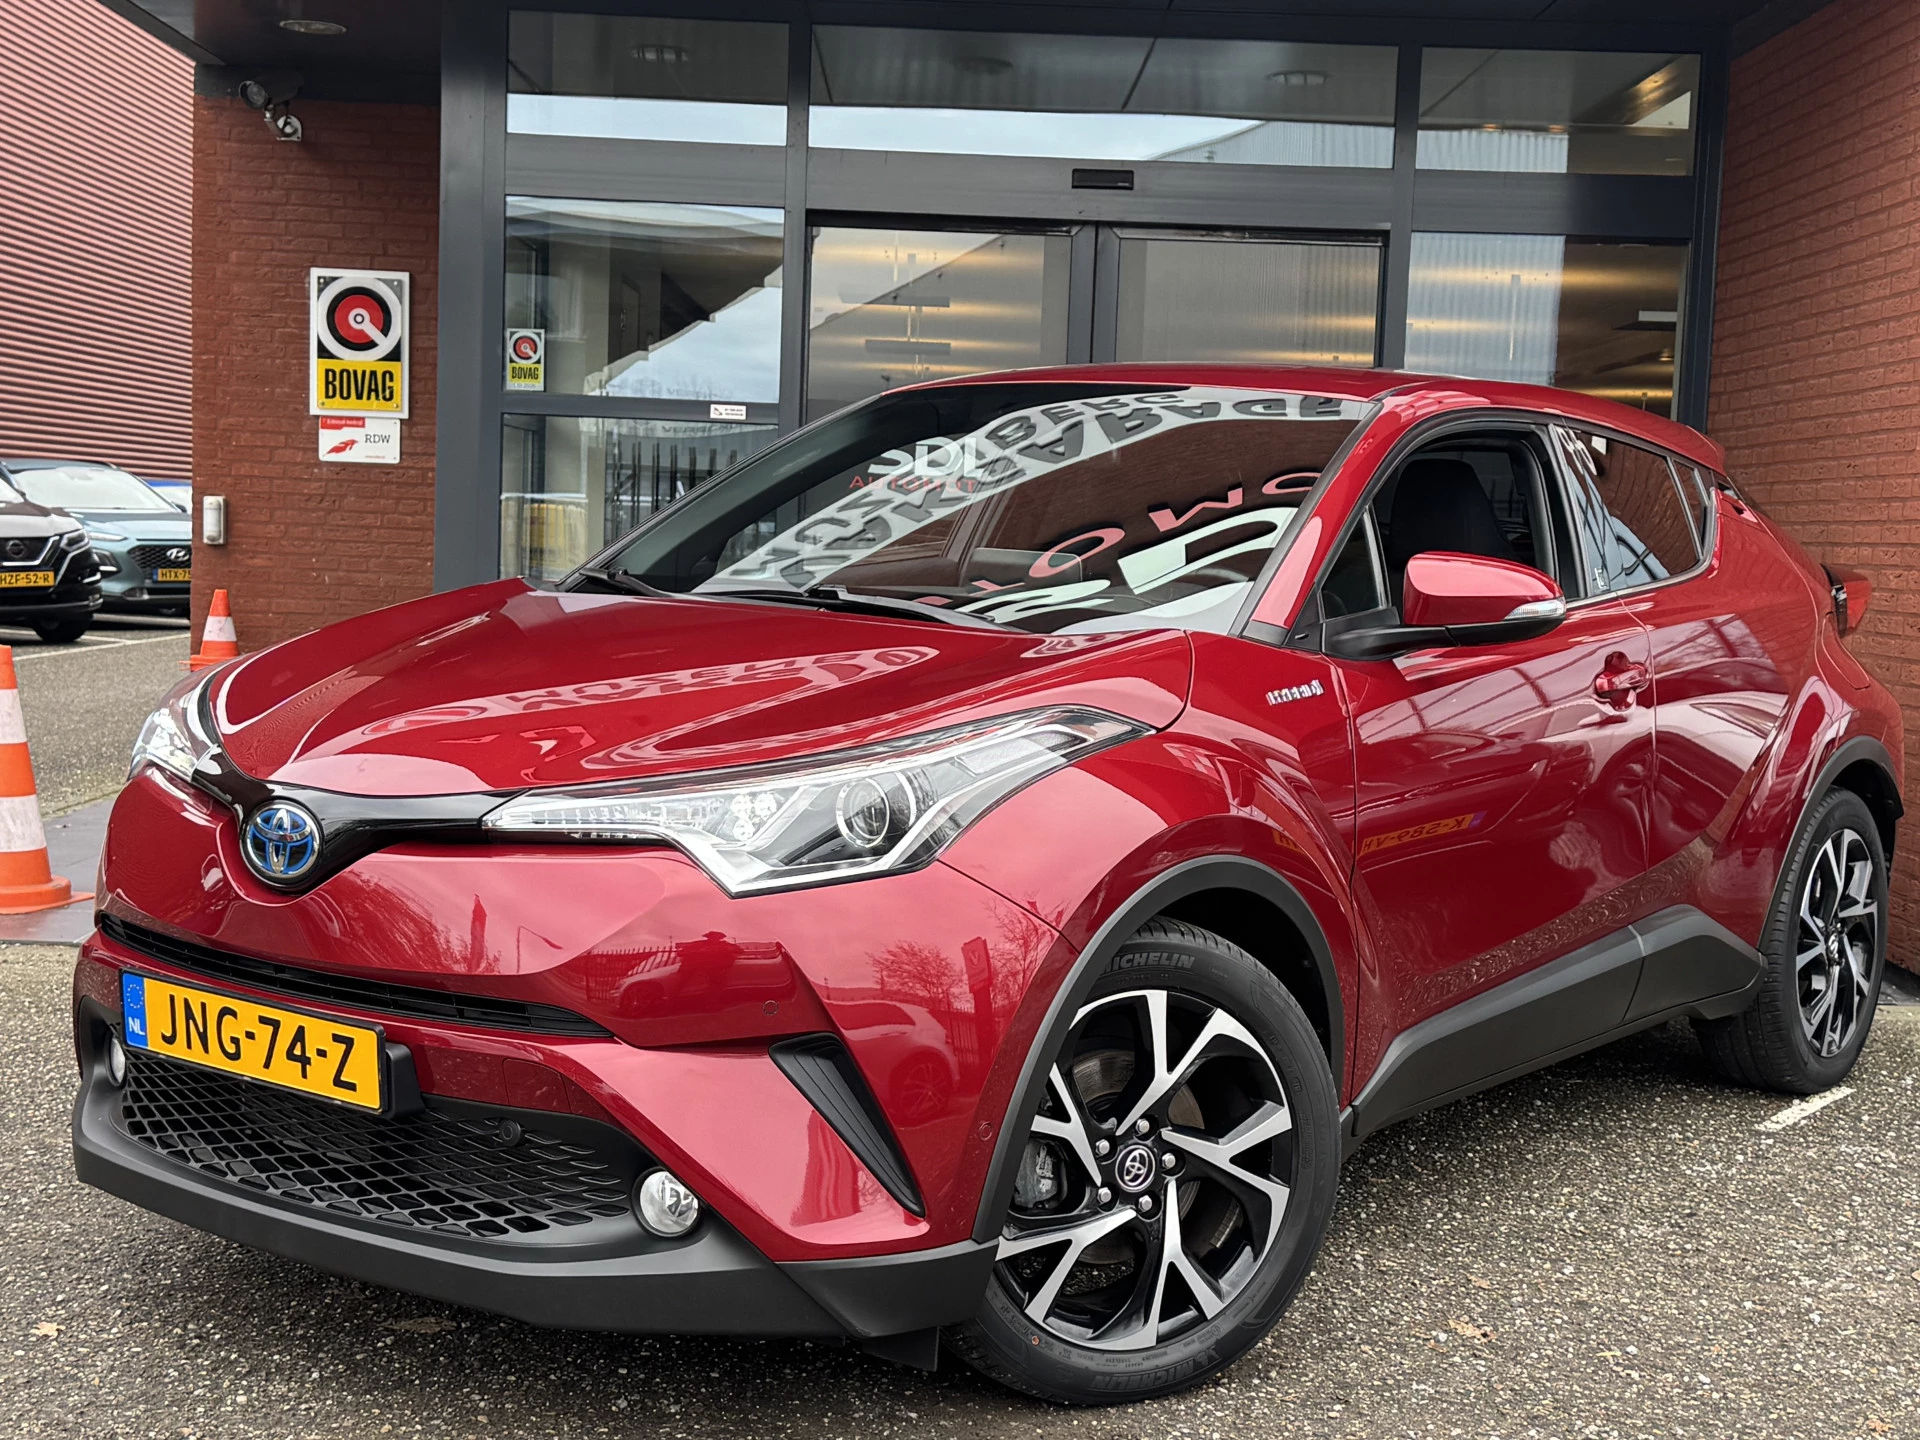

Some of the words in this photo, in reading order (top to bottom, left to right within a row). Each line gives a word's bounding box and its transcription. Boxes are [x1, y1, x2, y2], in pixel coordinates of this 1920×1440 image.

[511, 366, 539, 380] BOVAG
[324, 368, 394, 401] BOVAG
[364, 433, 391, 444] RDW
[0, 572, 50, 585] HZF-52-R
[128, 1016, 146, 1036] NL
[160, 993, 358, 1093] JNG-74-Z
